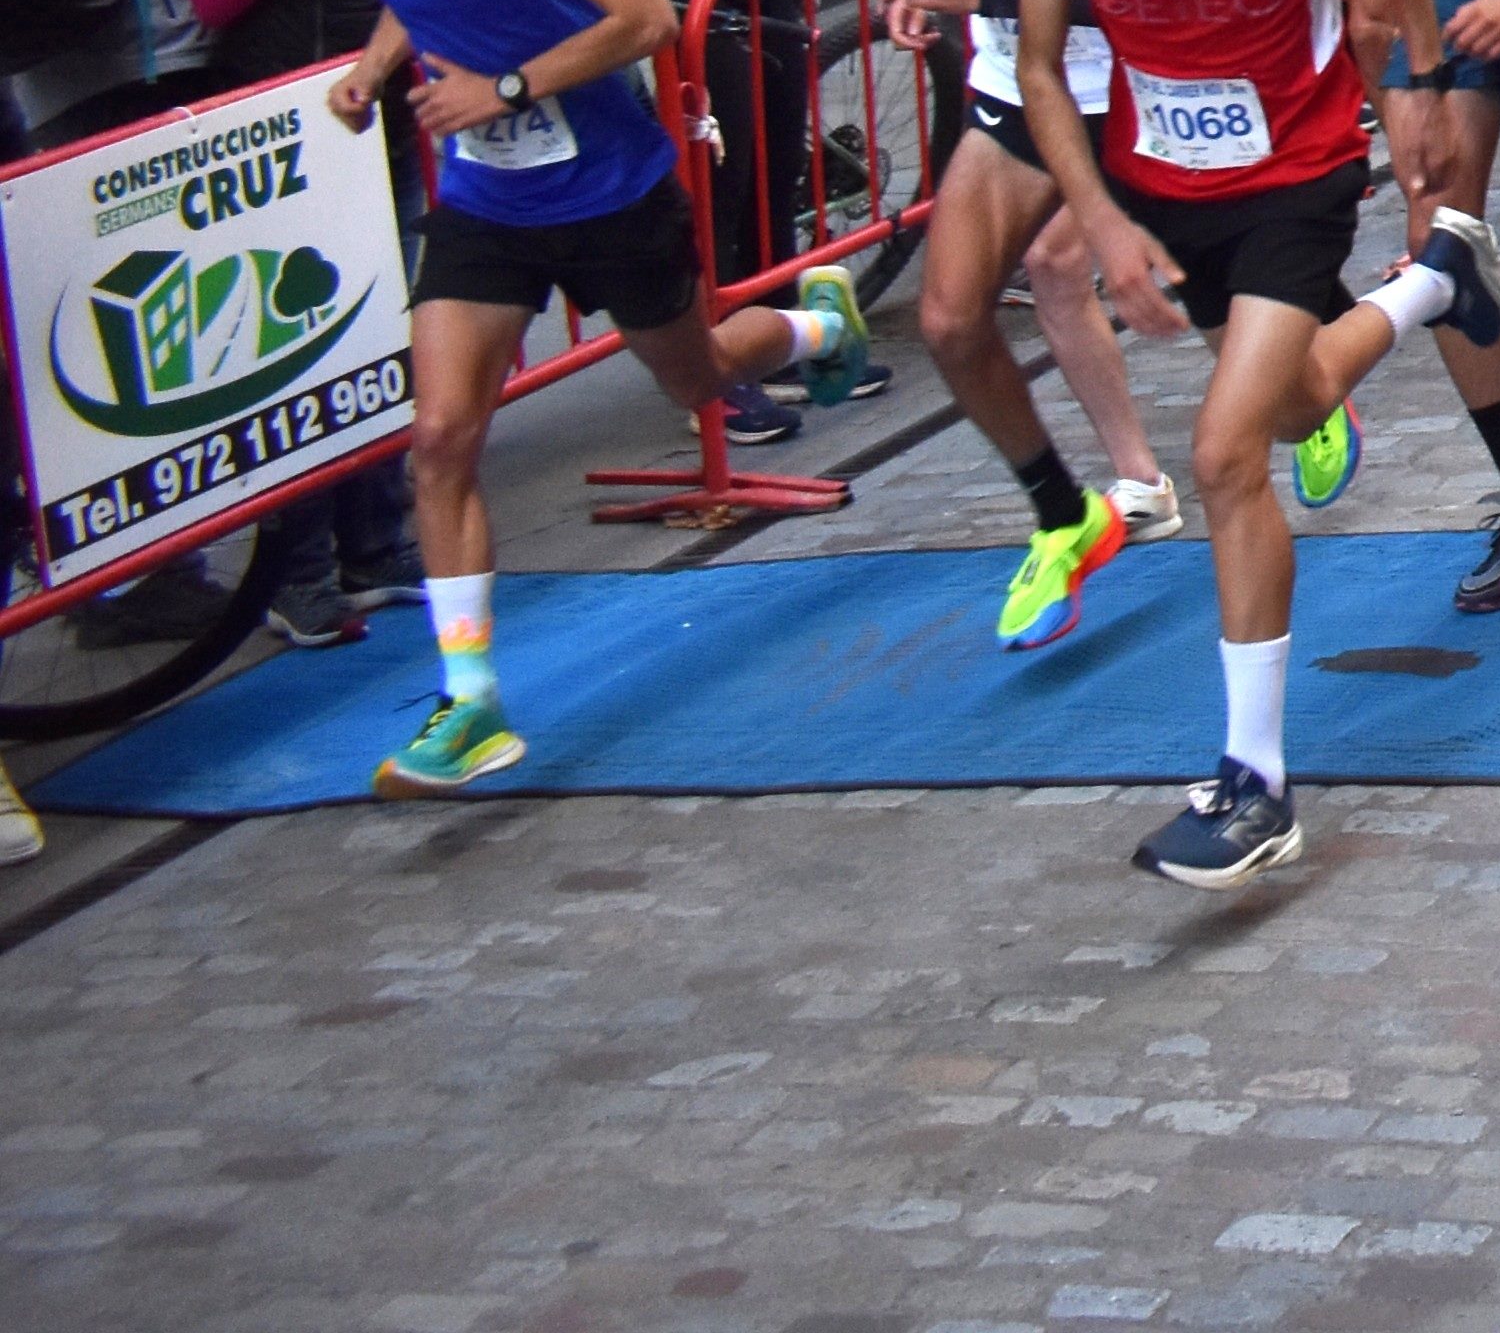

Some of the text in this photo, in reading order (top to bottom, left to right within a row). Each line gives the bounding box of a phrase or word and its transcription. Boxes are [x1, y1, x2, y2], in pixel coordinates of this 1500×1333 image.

[93, 107, 302, 204] CONSTRUCCIONS
[1152, 103, 1253, 141] 1068
[179, 140, 309, 231] CRUZ
[62, 358, 406, 545] Tel. 972 112 960
